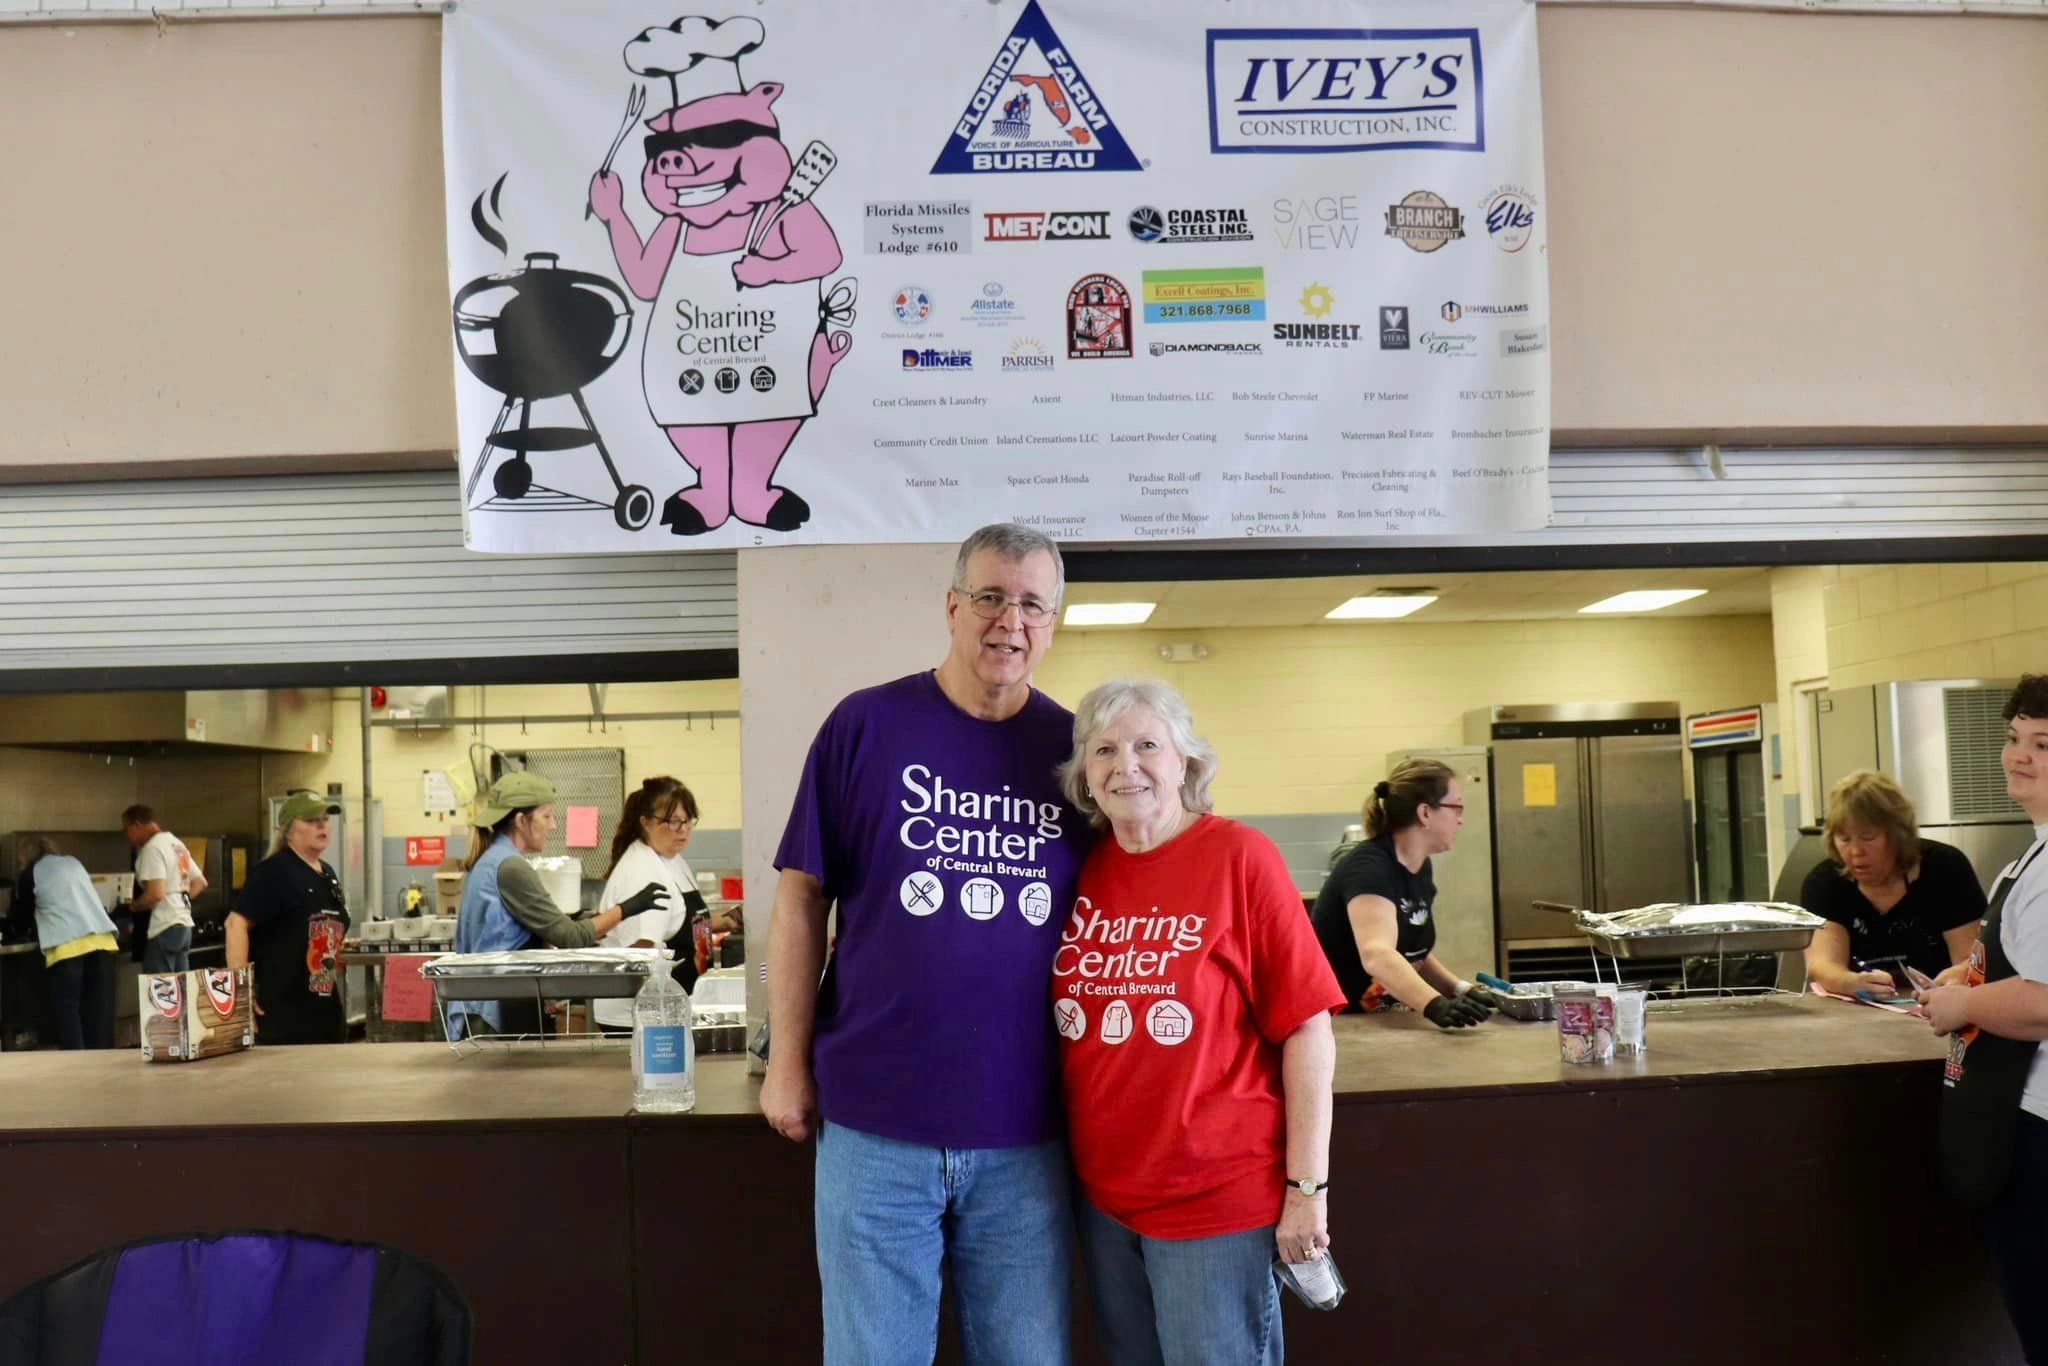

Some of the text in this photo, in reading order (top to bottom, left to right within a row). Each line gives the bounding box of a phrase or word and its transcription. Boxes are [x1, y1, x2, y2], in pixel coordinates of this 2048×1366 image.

[1234, 52, 1463, 102] IVEY'S
[955, 35, 1028, 141] FLORIDA
[1046, 47, 1109, 132] FARM
[1239, 116, 1457, 136] CONSTRUCTION, INC.
[971, 142, 997, 150] VOICE
[1014, 140, 1075, 149] AGRICULTURE
[972, 152, 1096, 170] BUREAU
[866, 203, 970, 217] Florida Missiles
[1168, 209, 1249, 224] COASTAL
[1273, 196, 1359, 224] SAGE
[1396, 208, 1453, 228] BRANCH
[1486, 200, 1535, 234] Elks
[891, 223, 945, 237] Systems
[1169, 223, 1252, 236] STEEL INC.
[1273, 224, 1359, 250] VIEW
[879, 241, 958, 256] Lodge #610
[970, 300, 1015, 310] Allstate
[1160, 304, 1252, 317] 321.868.7968
[675, 299, 777, 333] Sharing
[1273, 323, 1361, 341] SUNBELT
[676, 331, 766, 355] Center
[1165, 343, 1262, 353] DIAMONDBACK
[693, 355, 767, 367] of Central Brevard
[1001, 355, 1055, 368] PARRISH
[872, 396, 988, 408] Crest Cleaners & Laundry
[1195, 392, 1214, 401] LLC
[1232, 392, 1250, 400] Bob
[1278, 392, 1319, 401] Chevrolet
[1378, 392, 1409, 400] Marine
[996, 434, 1099, 445] Island Cremations LLC
[1110, 432, 1218, 444] Lacourt Powder Coating
[1244, 432, 1309, 442] Sunrise Marina
[1341, 430, 1435, 441] Waterman Real Estate
[1451, 429, 1503, 440] Brombacher
[873, 436, 988, 449] Community Credit Union
[1007, 474, 1090, 488] Space Coast Honda
[1128, 472, 1165, 482] Paradise
[1222, 472, 1242, 484] Rays
[1244, 471, 1279, 482] Baseball
[1342, 470, 1380, 480] Precision
[905, 478, 960, 488] Marine Max
[1269, 485, 1286, 494] Inc.
[1372, 482, 1409, 494] Cleaning
[1140, 486, 1190, 497] Dumpsters
[1013, 515, 1087, 525] World Insurance
[1120, 514, 1153, 523] Women
[1154, 513, 1164, 522] of
[1165, 513, 1180, 522] the
[1231, 510, 1328, 522] Johns Benson & Johns
[1337, 510, 1356, 519] Ron
[1358, 510, 1373, 519] Jon
[1375, 508, 1393, 518] Surf
[1394, 508, 1417, 520] Shop
[1418, 508, 1427, 518] of
[1064, 528, 1084, 537] LLC
[1134, 526, 1196, 538] Chapter #1544
[900, 764, 1063, 839] Sharing
[900, 815, 1047, 862] Center
[926, 855, 1047, 879] of Central Brevard
[1062, 896, 1208, 951] Sharing
[1052, 943, 1180, 979] Center
[1068, 980, 1177, 997] of Central Brevard
